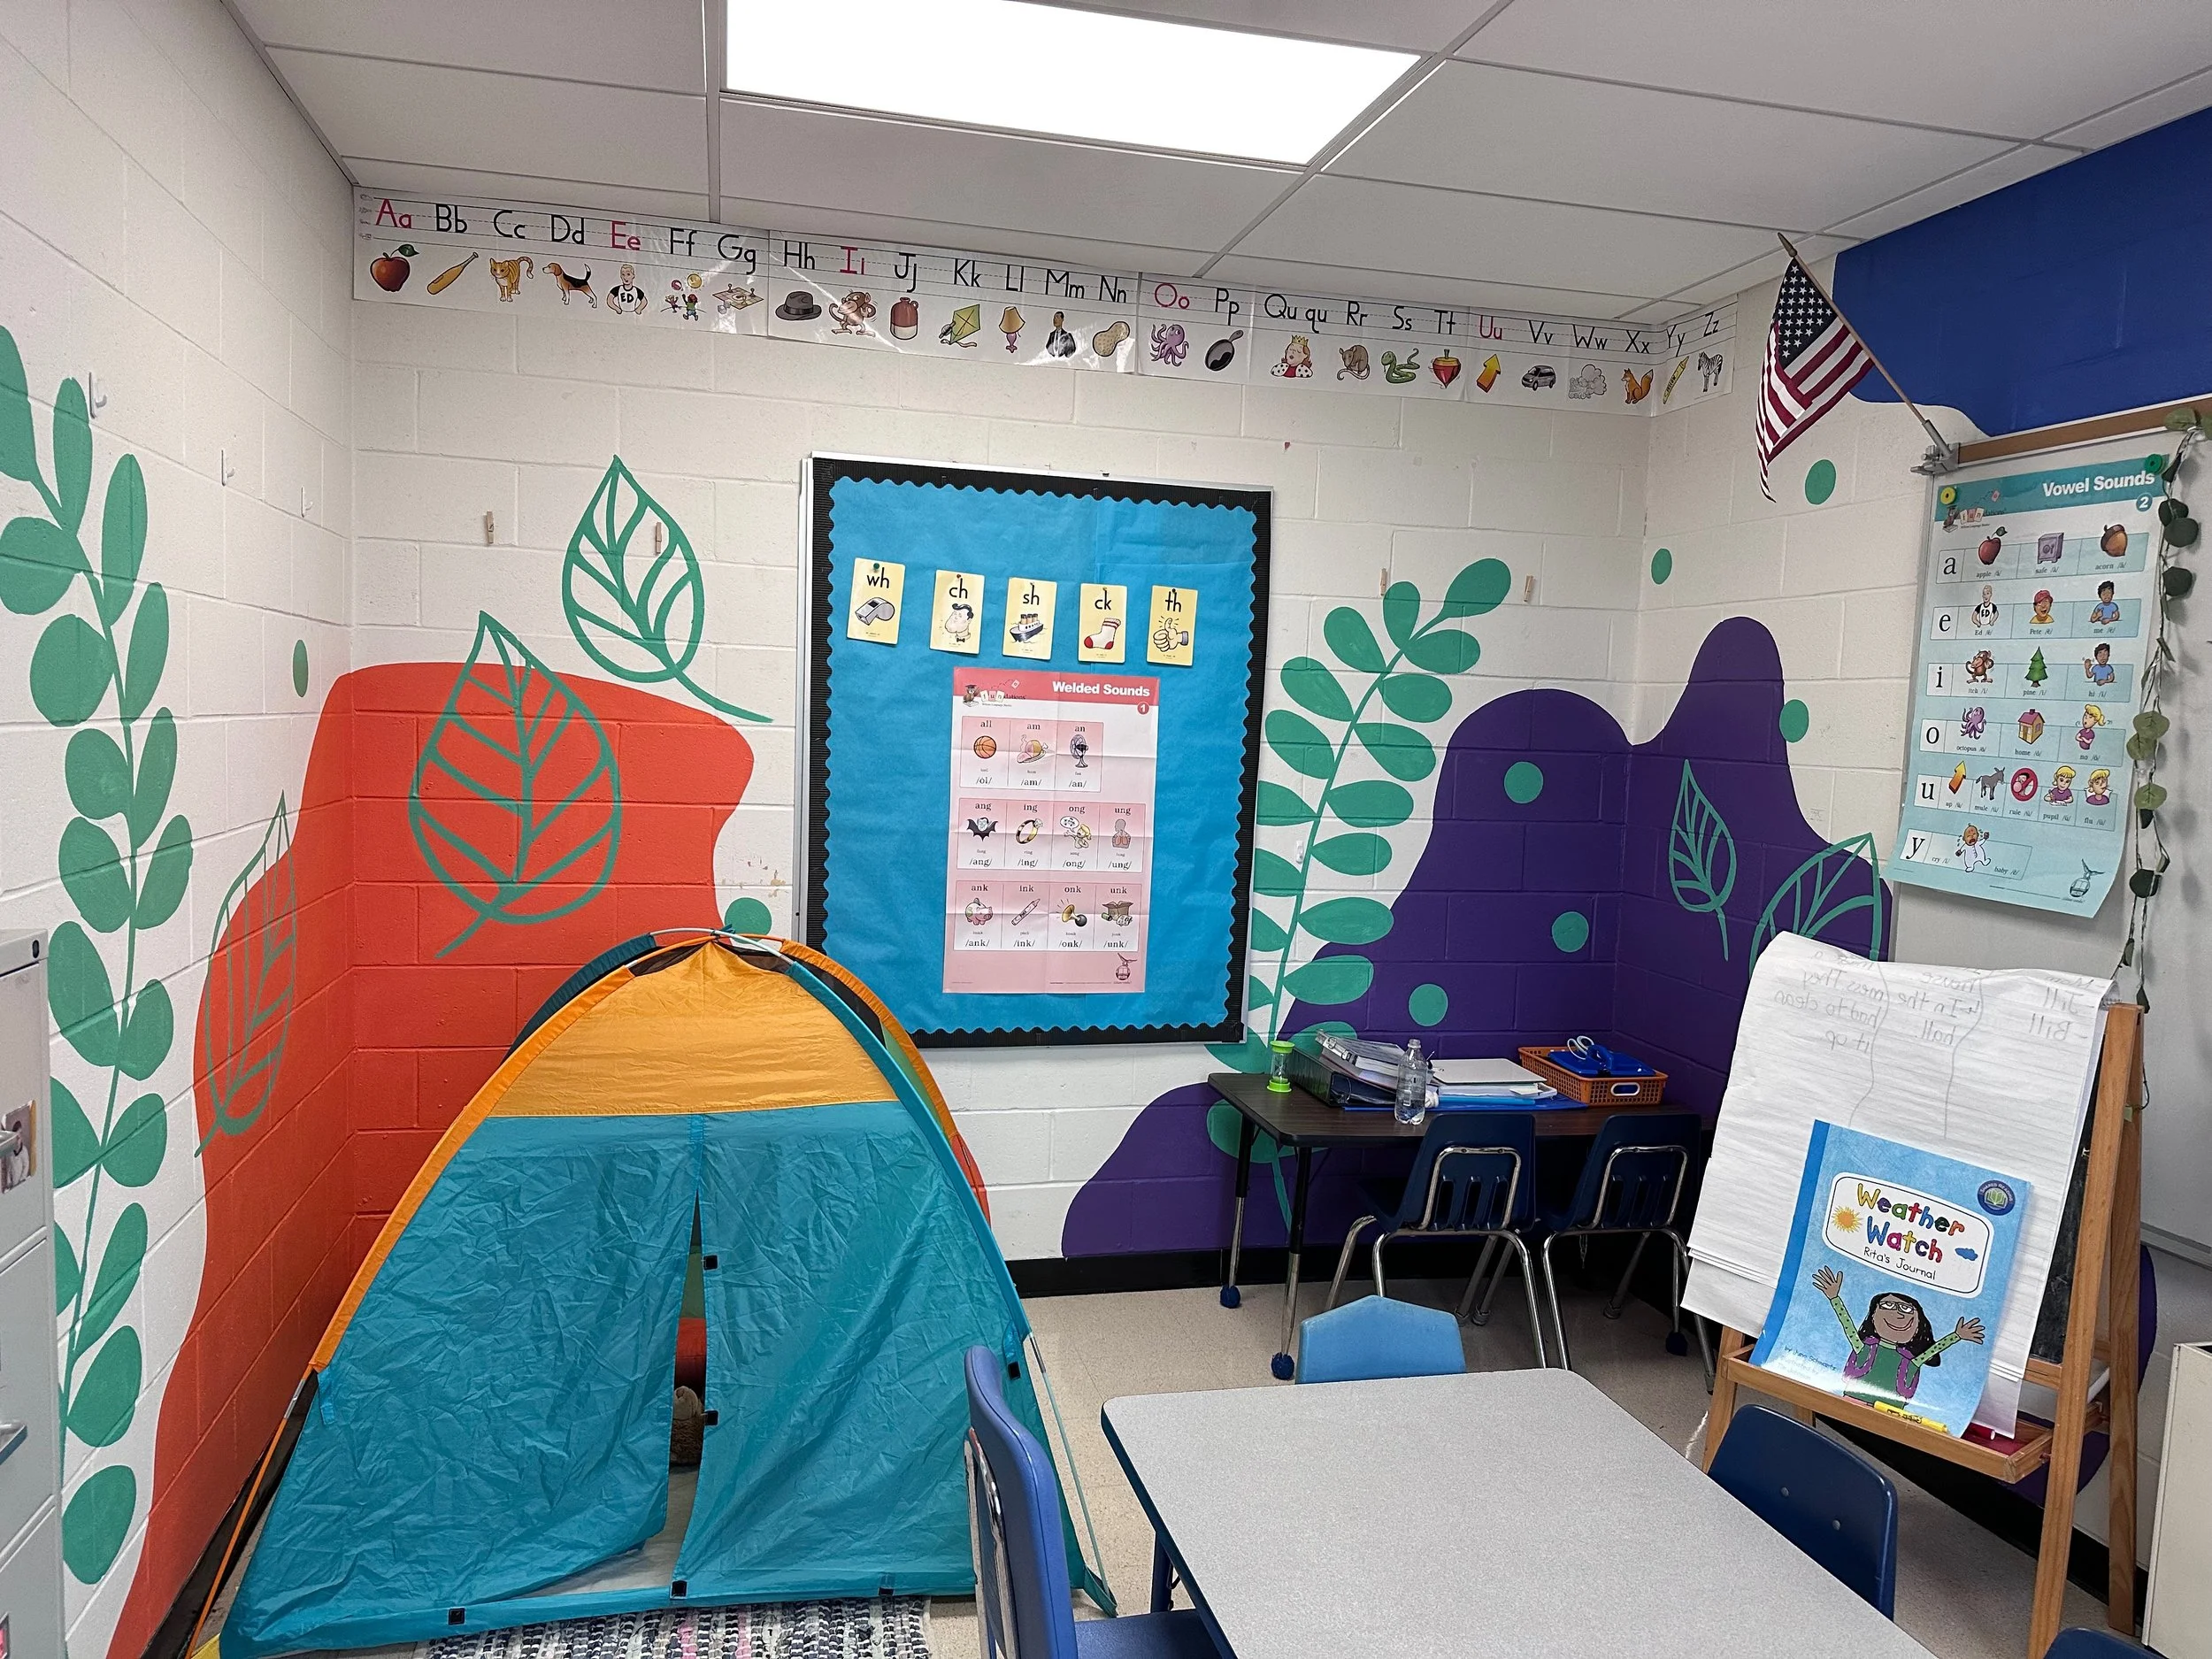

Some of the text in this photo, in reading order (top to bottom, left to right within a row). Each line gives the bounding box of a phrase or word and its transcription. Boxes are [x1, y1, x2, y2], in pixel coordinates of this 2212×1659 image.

[375, 198, 757, 275] Aa Bb Cc Dd Ee Ff Gg
[784, 240, 815, 270] Hh
[840, 246, 864, 275] Ii
[894, 252, 917, 293] Jj
[954, 257, 982, 288] Kk
[1046, 269, 1085, 299] Mm
[1099, 275, 1127, 303] Nn
[619, 291, 634, 303] ED
[1154, 282, 1455, 335] Oo Pp Qu qu Rr Ss Tt
[1479, 311, 1720, 357] Uu Vv Ww Xx Yy Zz
[2042, 470, 2155, 497] Vowel Sounds
[2139, 496, 2149, 509] 2
[1942, 556, 1957, 576] a
[865, 567, 890, 589] wh
[949, 579, 969, 599] ch
[1022, 585, 1041, 605] sh
[1094, 589, 1112, 611] ck
[1164, 591, 1182, 612] th
[1980, 609, 1990, 618] ED
[1939, 613, 1951, 633] e
[1935, 666, 1943, 688] i
[1052, 680, 1150, 697] Welded Sounds
[980, 719, 992, 728] all
[1925, 726, 1939, 744] o
[1921, 782, 1935, 801] u
[974, 802, 992, 811] ang
[1023, 803, 1038, 813] ing
[1068, 805, 1086, 815] ong
[1114, 806, 1132, 816] ung
[2042, 812, 2059, 821] pupil
[1905, 836, 1926, 860] y
[969, 857, 993, 867] /ang/
[1017, 857, 1039, 867] /ing/
[1062, 858, 1087, 868] /ong/
[1107, 860, 1133, 870] /ung/
[1993, 865, 2008, 874] baby
[1064, 885, 1082, 894] onk
[1110, 886, 1127, 895] unk
[965, 939, 990, 948] /ank/
[1013, 939, 1036, 948] /ink/
[1058, 940, 1083, 949] /onk/
[1103, 941, 1129, 949] /unk/
[1855, 1183, 1965, 1237] Weather
[1866, 1216, 1944, 1263] Watch
[1863, 1246, 1937, 1280] Rita's Journal
